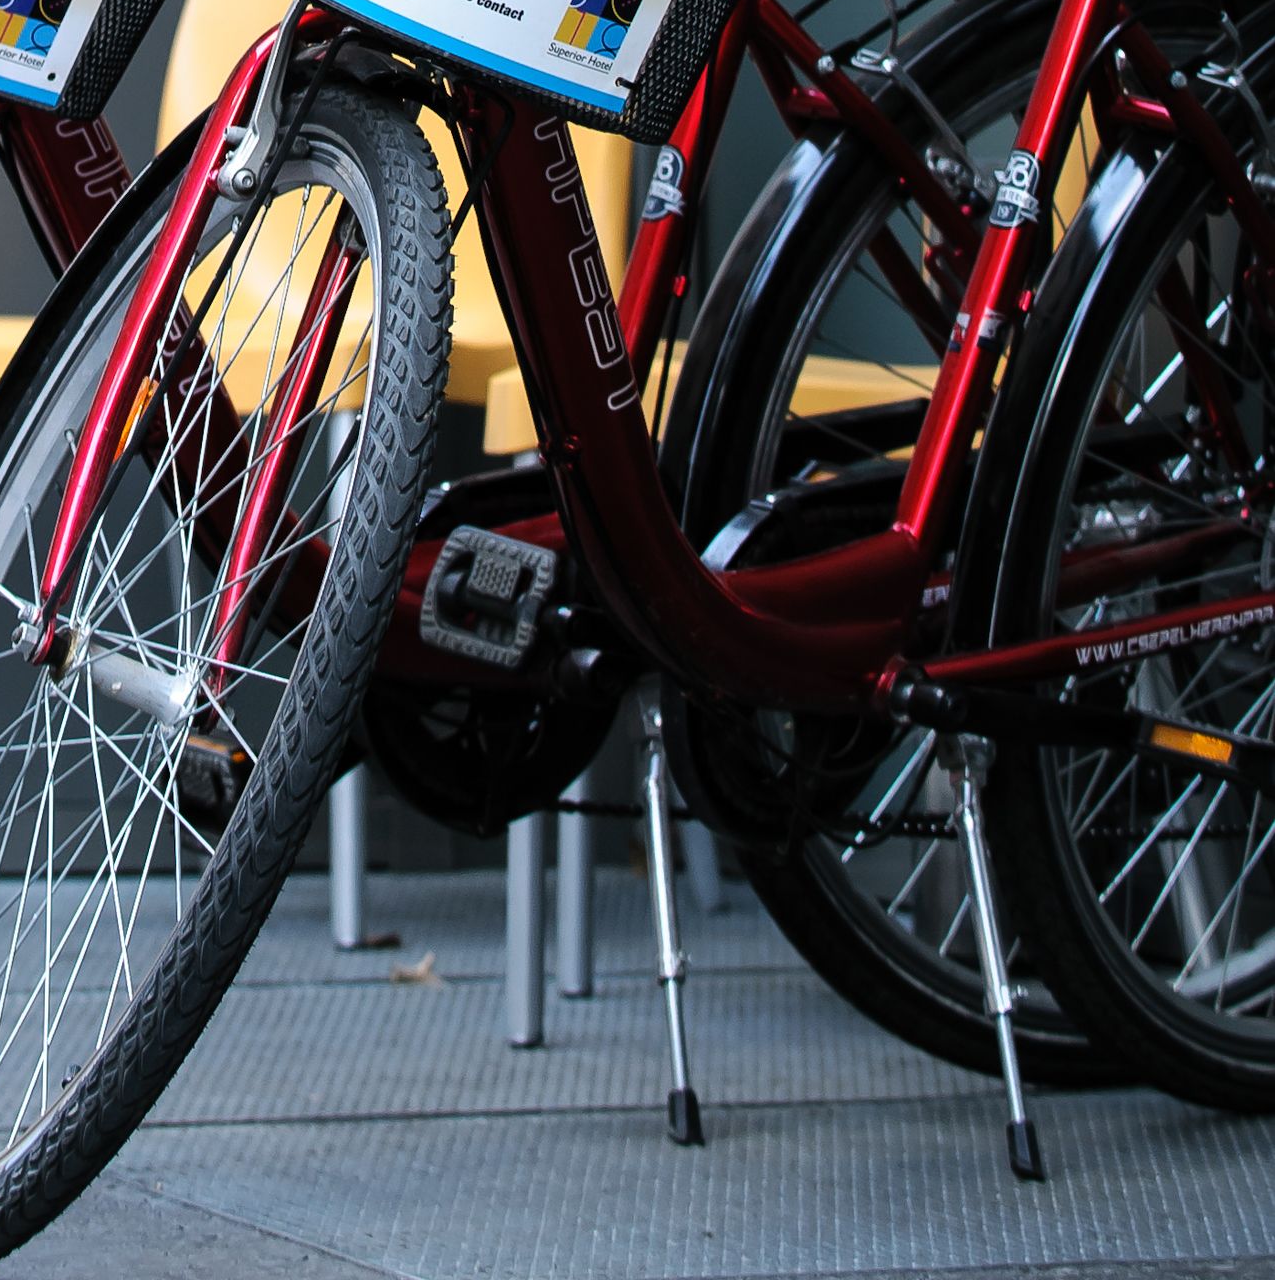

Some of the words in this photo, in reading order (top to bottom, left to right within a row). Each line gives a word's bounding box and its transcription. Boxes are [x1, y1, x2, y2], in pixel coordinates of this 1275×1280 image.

[19, 52, 45, 68] Hotel
[548, 42, 587, 58] Superior
[588, 55, 613, 71] Hotel
